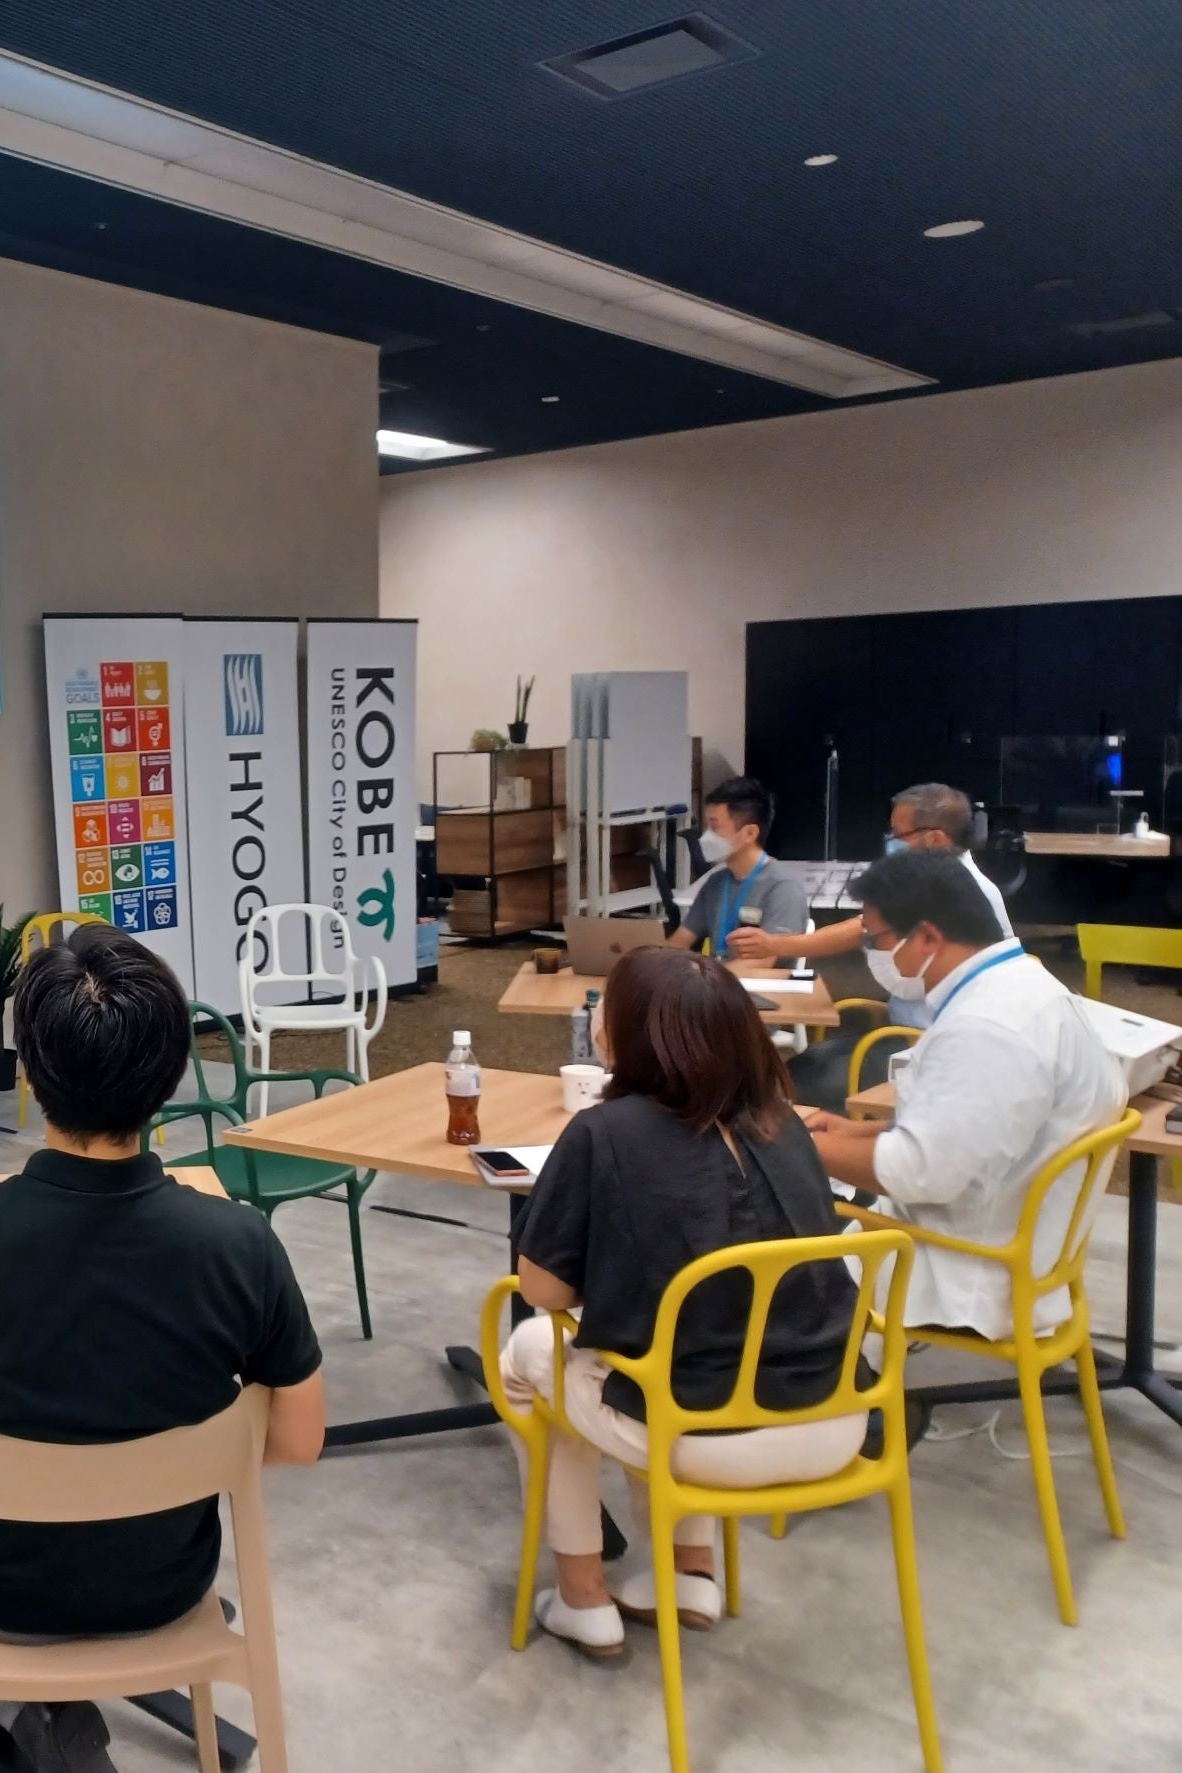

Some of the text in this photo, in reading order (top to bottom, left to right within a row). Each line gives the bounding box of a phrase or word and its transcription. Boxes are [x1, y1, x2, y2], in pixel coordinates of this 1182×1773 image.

[331, 667, 346, 771] UNESCO
[355, 667, 395, 856] KOBE
[329, 779, 346, 829] City
[332, 835, 347, 859] of
[229, 751, 269, 975] HYOGO
